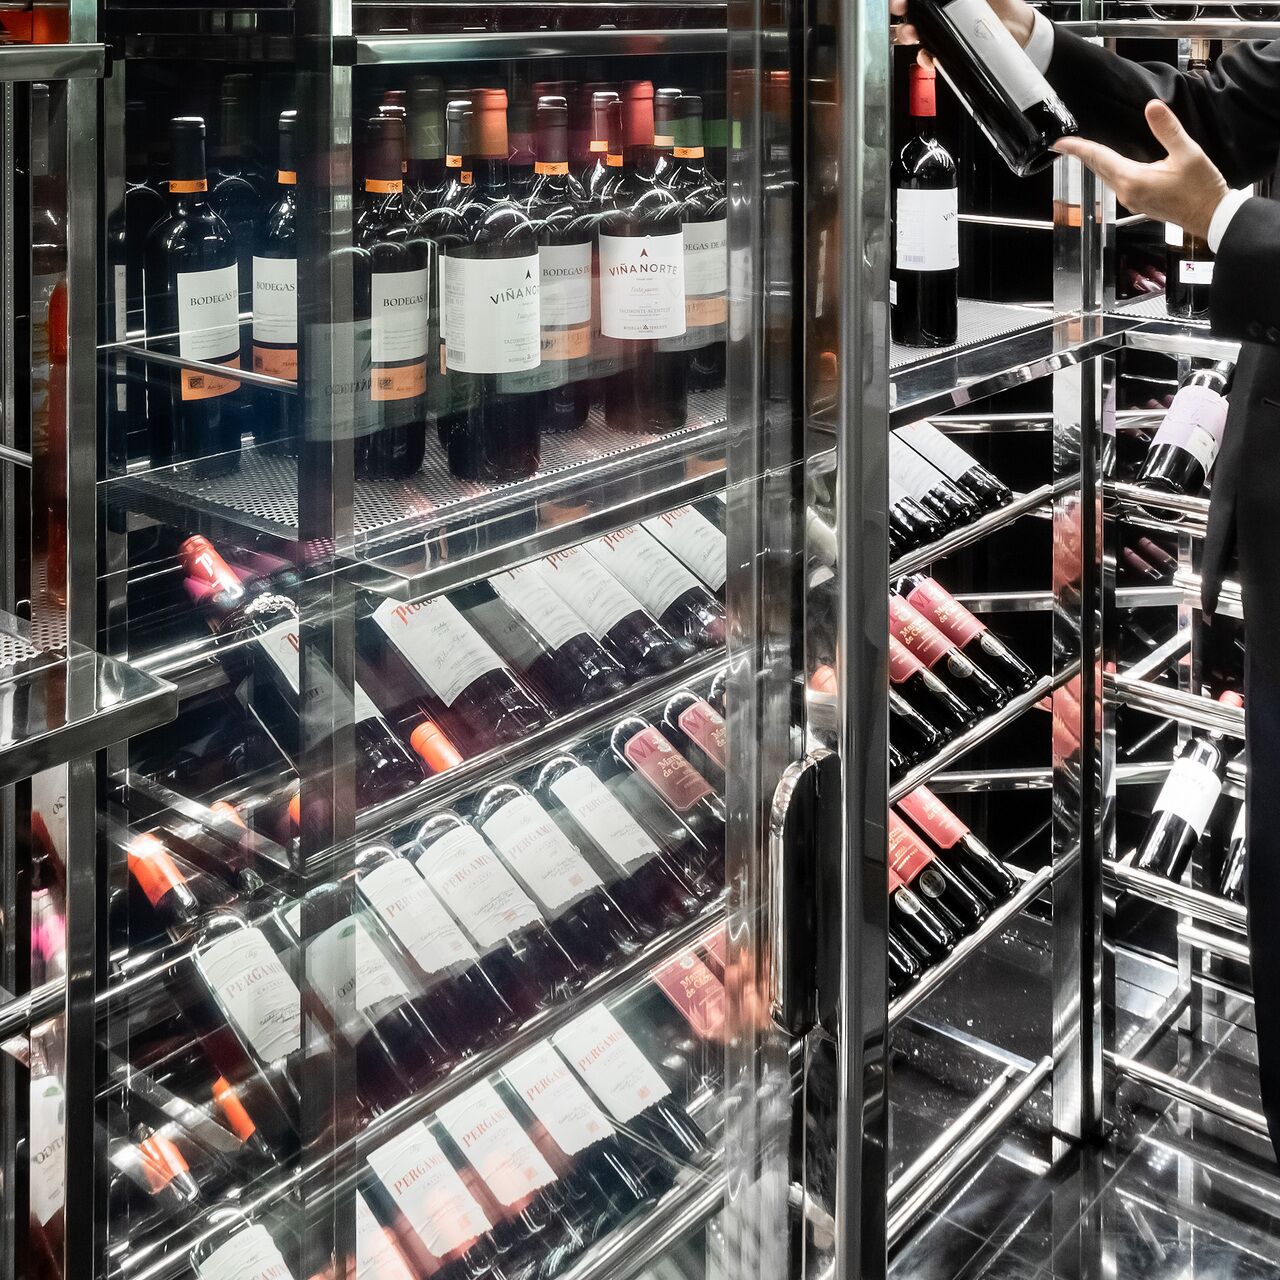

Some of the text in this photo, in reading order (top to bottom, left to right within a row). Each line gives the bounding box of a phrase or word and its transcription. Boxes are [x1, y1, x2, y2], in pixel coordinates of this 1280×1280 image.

[543, 266, 583, 278] BODEGAS
[256, 281, 296, 292] BODEGAS
[190, 292, 233, 308] BODEGAS
[383, 294, 424, 308] BODEGAS
[489, 285, 538, 306] VIÑANO
